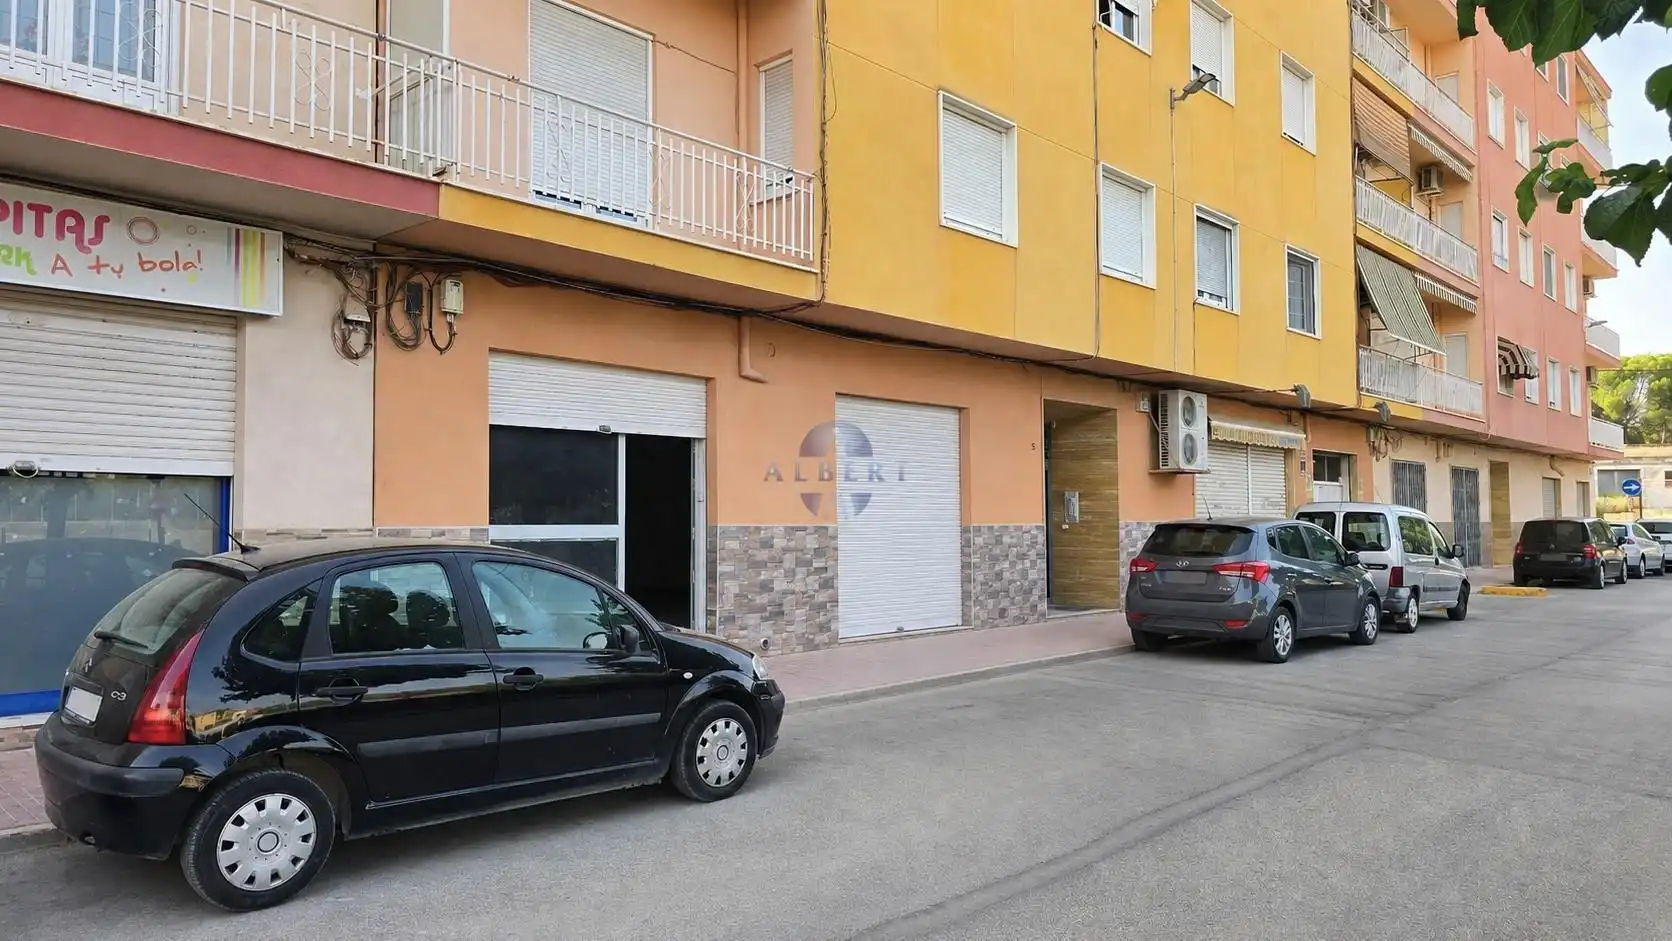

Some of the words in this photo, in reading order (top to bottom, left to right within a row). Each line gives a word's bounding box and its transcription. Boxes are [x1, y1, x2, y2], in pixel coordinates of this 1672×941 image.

[51, 253, 73, 278] A
[138, 250, 203, 272] bola!
[111, 690, 127, 701] C3
